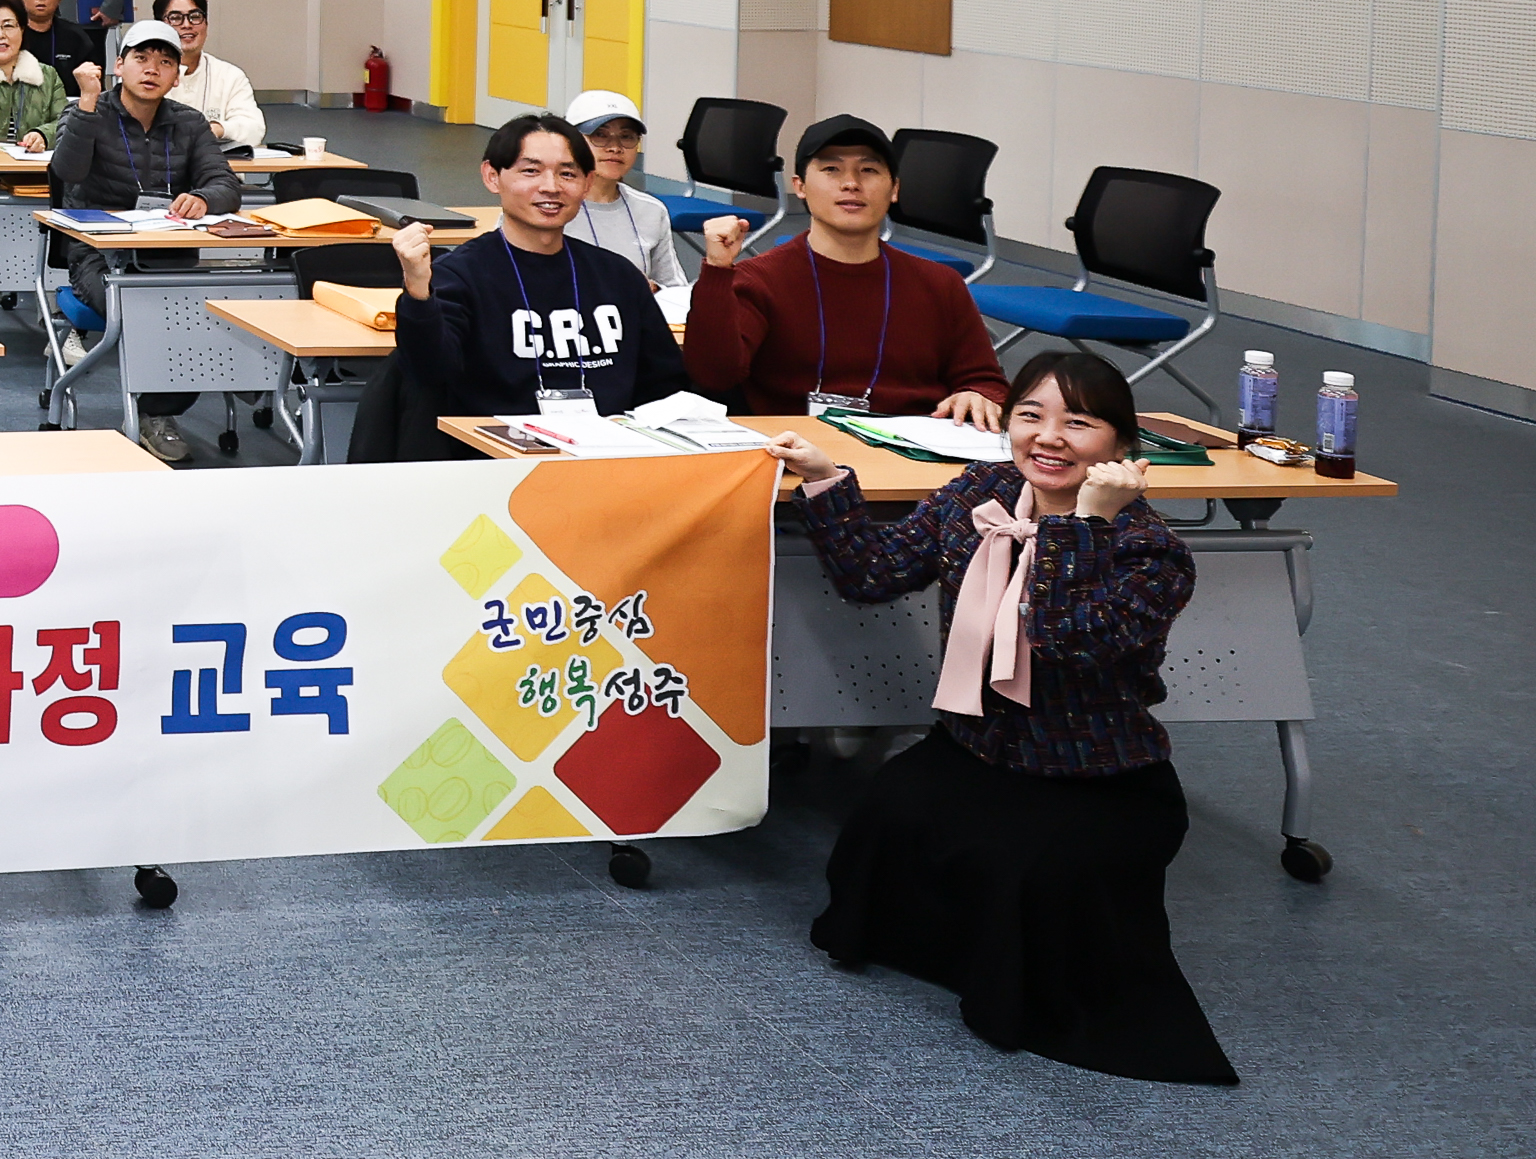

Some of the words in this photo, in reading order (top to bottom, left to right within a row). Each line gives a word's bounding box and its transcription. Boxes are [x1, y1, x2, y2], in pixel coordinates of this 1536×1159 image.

[511, 304, 623, 359] G.R.P
[481, 593, 651, 649] 군민중심
[160, 611, 355, 736] 교육
[519, 658, 685, 728] 행복성주
